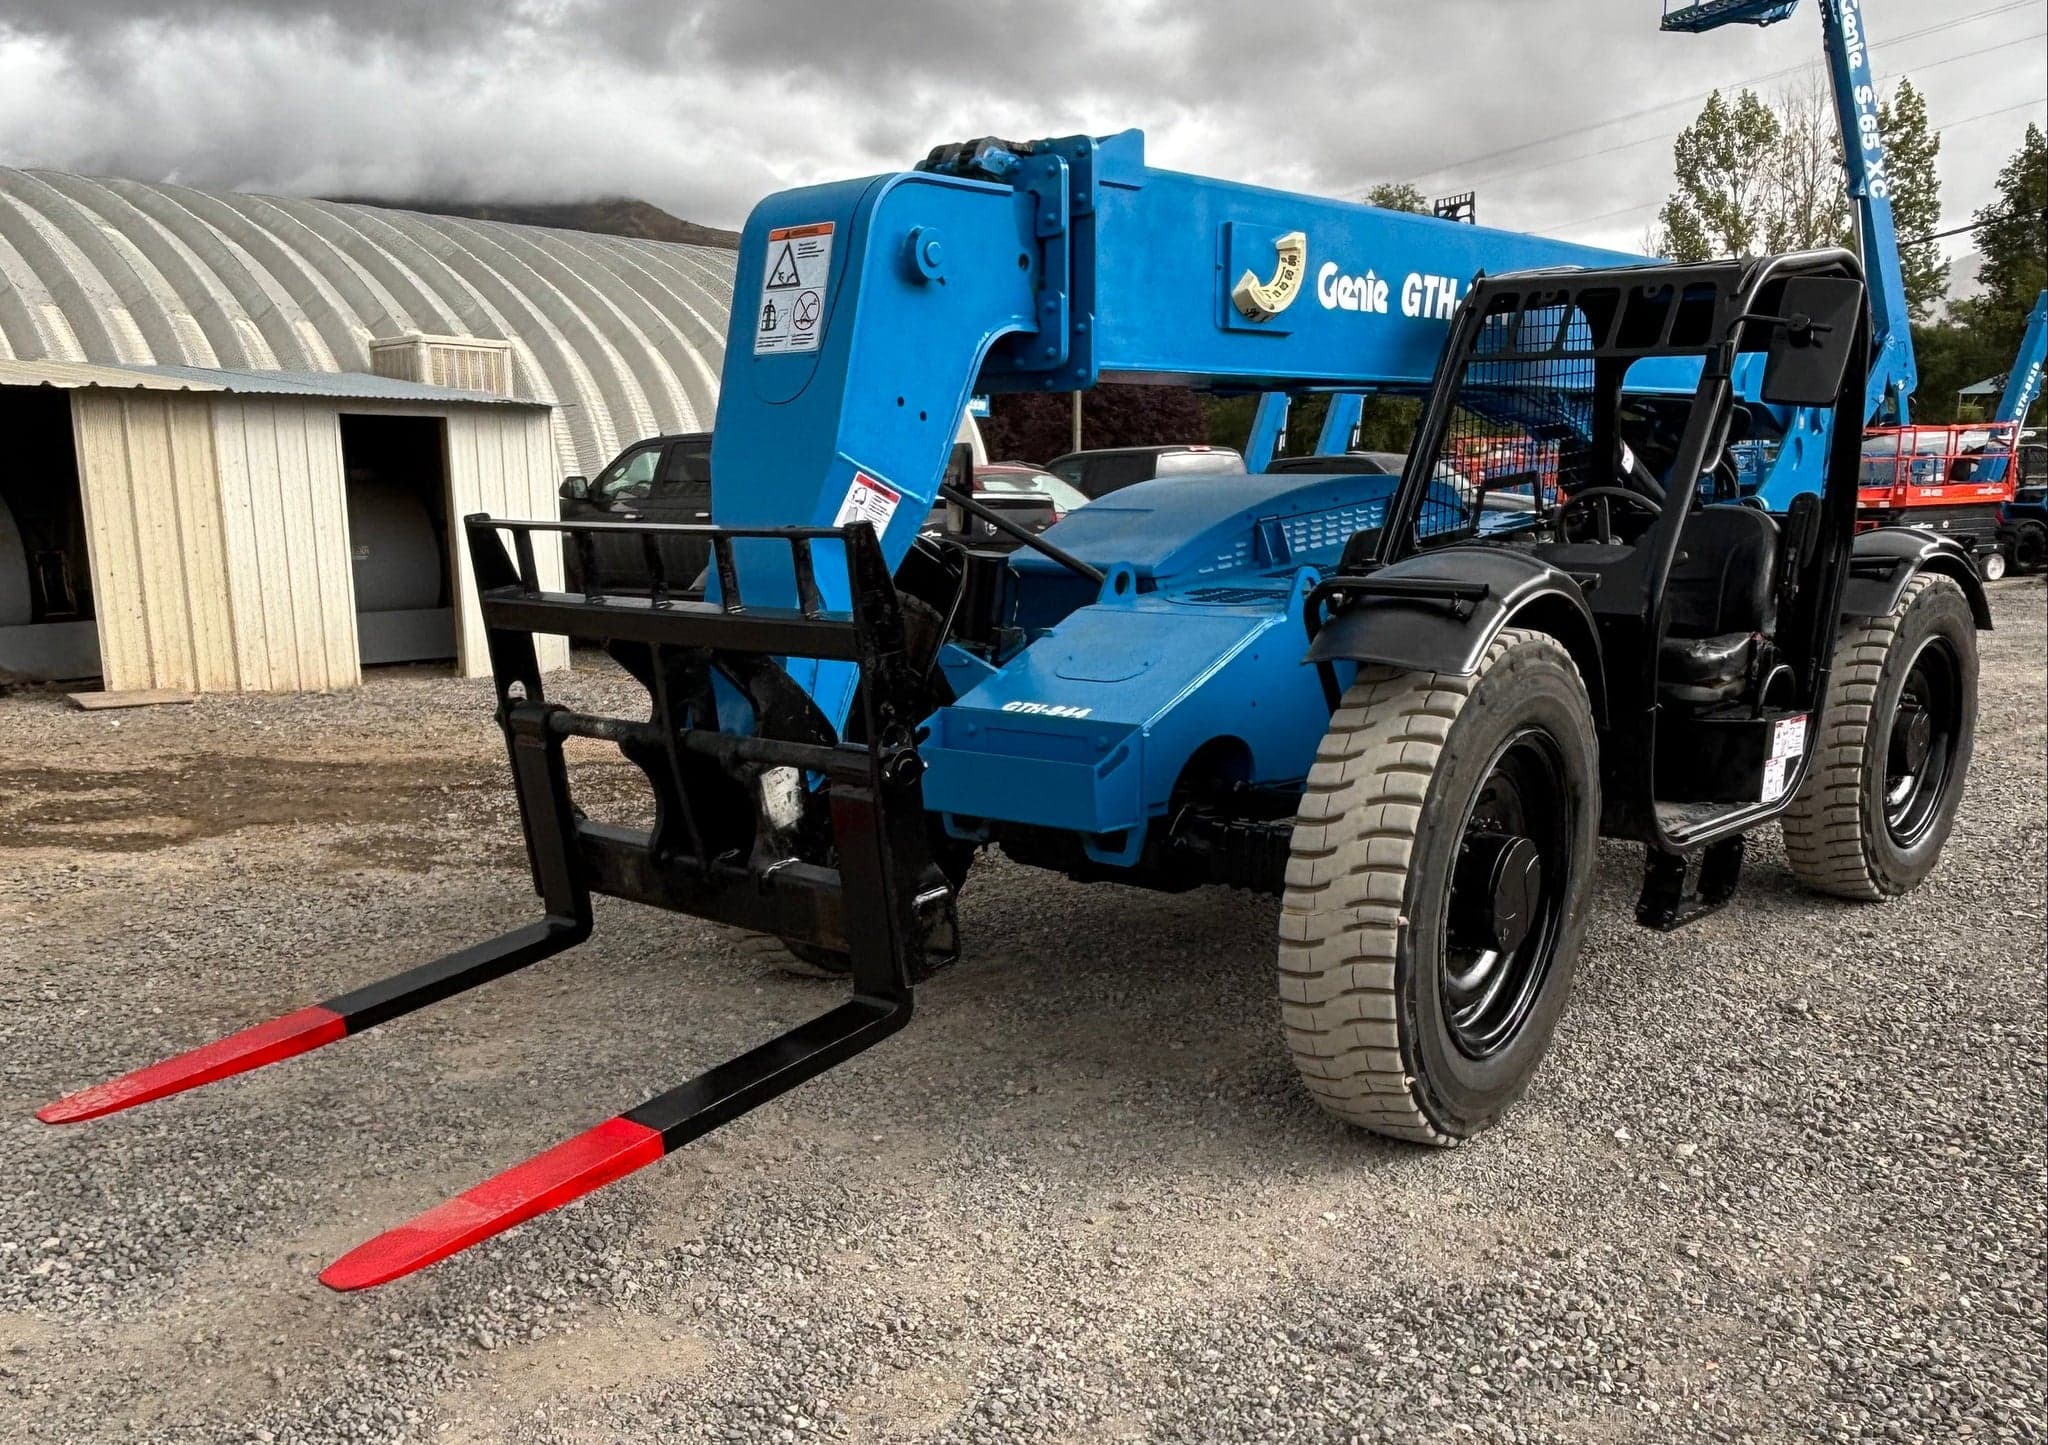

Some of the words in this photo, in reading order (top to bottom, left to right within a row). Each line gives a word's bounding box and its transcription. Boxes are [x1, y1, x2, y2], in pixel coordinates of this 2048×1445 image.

[1840, 0, 1865, 72] Genie
[1854, 85, 1881, 151] S-65
[1865, 159, 1888, 199] XC
[1317, 261, 1389, 314] Genie
[1402, 272, 1473, 320] GTH-
[1001, 701, 1093, 719] GTH-844
